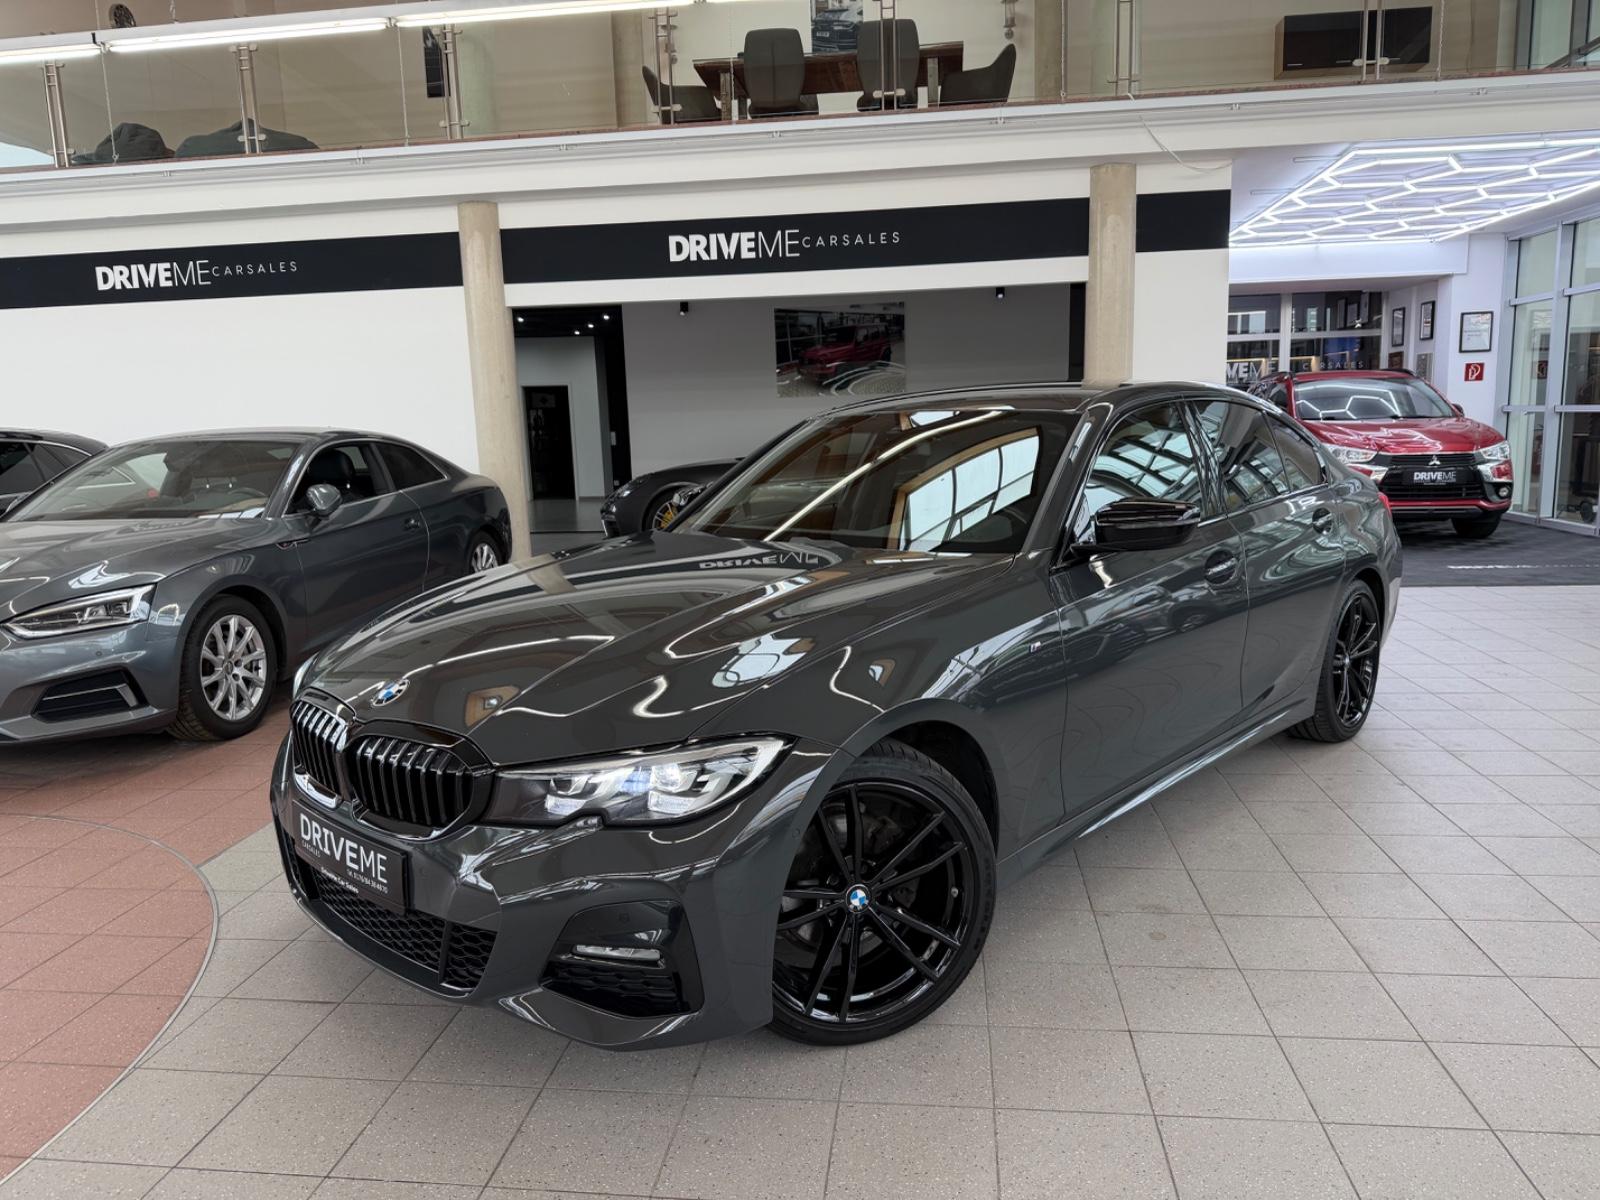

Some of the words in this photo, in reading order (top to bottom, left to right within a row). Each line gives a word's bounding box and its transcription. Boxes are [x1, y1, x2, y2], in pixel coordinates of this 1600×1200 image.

[668, 229, 801, 262] DRIVEME
[801, 231, 901, 249] CARSALES
[95, 260, 212, 291] DRIVEME
[211, 261, 298, 277] CARSALES
[1302, 360, 1364, 370] CRSALES
[1413, 471, 1457, 481] DRIVEME
[300, 813, 388, 884] DRIVEME
